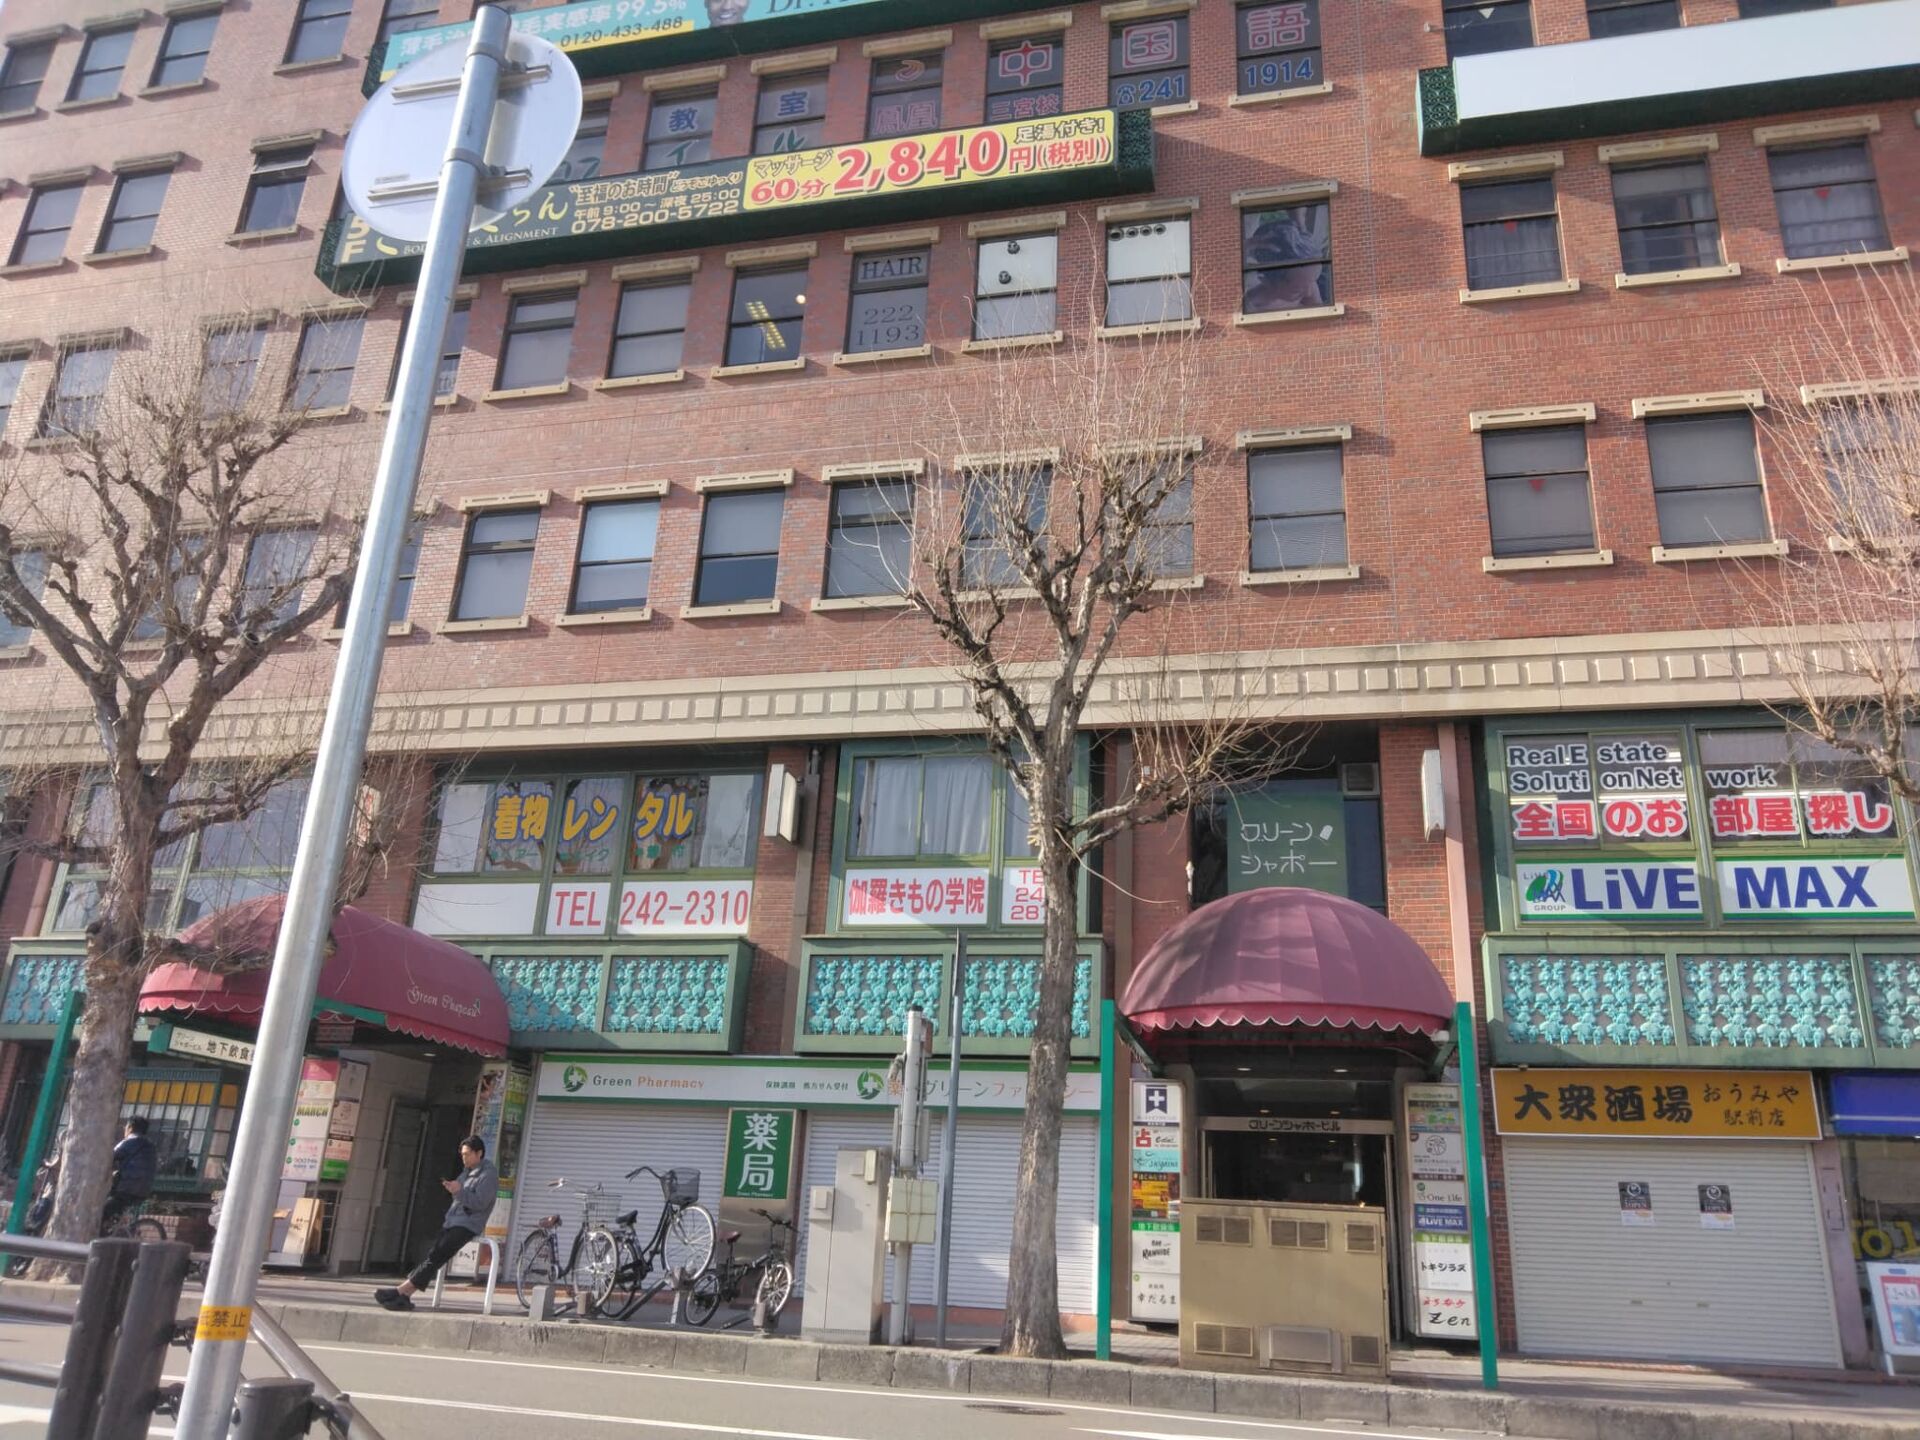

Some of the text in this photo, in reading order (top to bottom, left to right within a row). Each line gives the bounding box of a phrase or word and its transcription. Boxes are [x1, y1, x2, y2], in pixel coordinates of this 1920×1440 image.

[560, 16, 683, 48] 0120-433-488
[1000, 40, 1053, 86] 中
[1246, 3, 1311, 50] 語
[1138, 56, 1313, 101] 241 1914
[668, 92, 808, 132] 教 室
[1015, 117, 1106, 145] 足湯付き!
[750, 120, 1112, 206] 60分 2,840 円(税別)
[753, 148, 834, 180] マッサージ
[571, 199, 739, 235] 078-200-5722
[574, 207, 601, 221] 午前
[603, 202, 641, 216] 9:00
[690, 188, 740, 204] 25:00
[484, 226, 559, 245] ALIGNMENT
[861, 255, 923, 280] HAIR
[863, 304, 914, 326] 222
[855, 323, 920, 347] 1193
[1240, 848, 1338, 874] シャポー
[1018, 869, 1045, 885] TE
[1570, 865, 1879, 911] LiVE MAX
[554, 889, 749, 927] TEL 242-2310
[848, 876, 987, 917] 伽羅きもの学院
[1015, 886, 1045, 903] 24
[1533, 904, 1567, 912] GROUP
[1010, 904, 1046, 921] 28
[592, 1073, 705, 1091] Green Pharmacy
[1514, 1082, 1800, 1124] 大衆酒場 おうみや
[1724, 1107, 1786, 1127] 駅前店
[738, 1112, 781, 1192] 薬局
[1428, 1311, 1471, 1327] Zen
